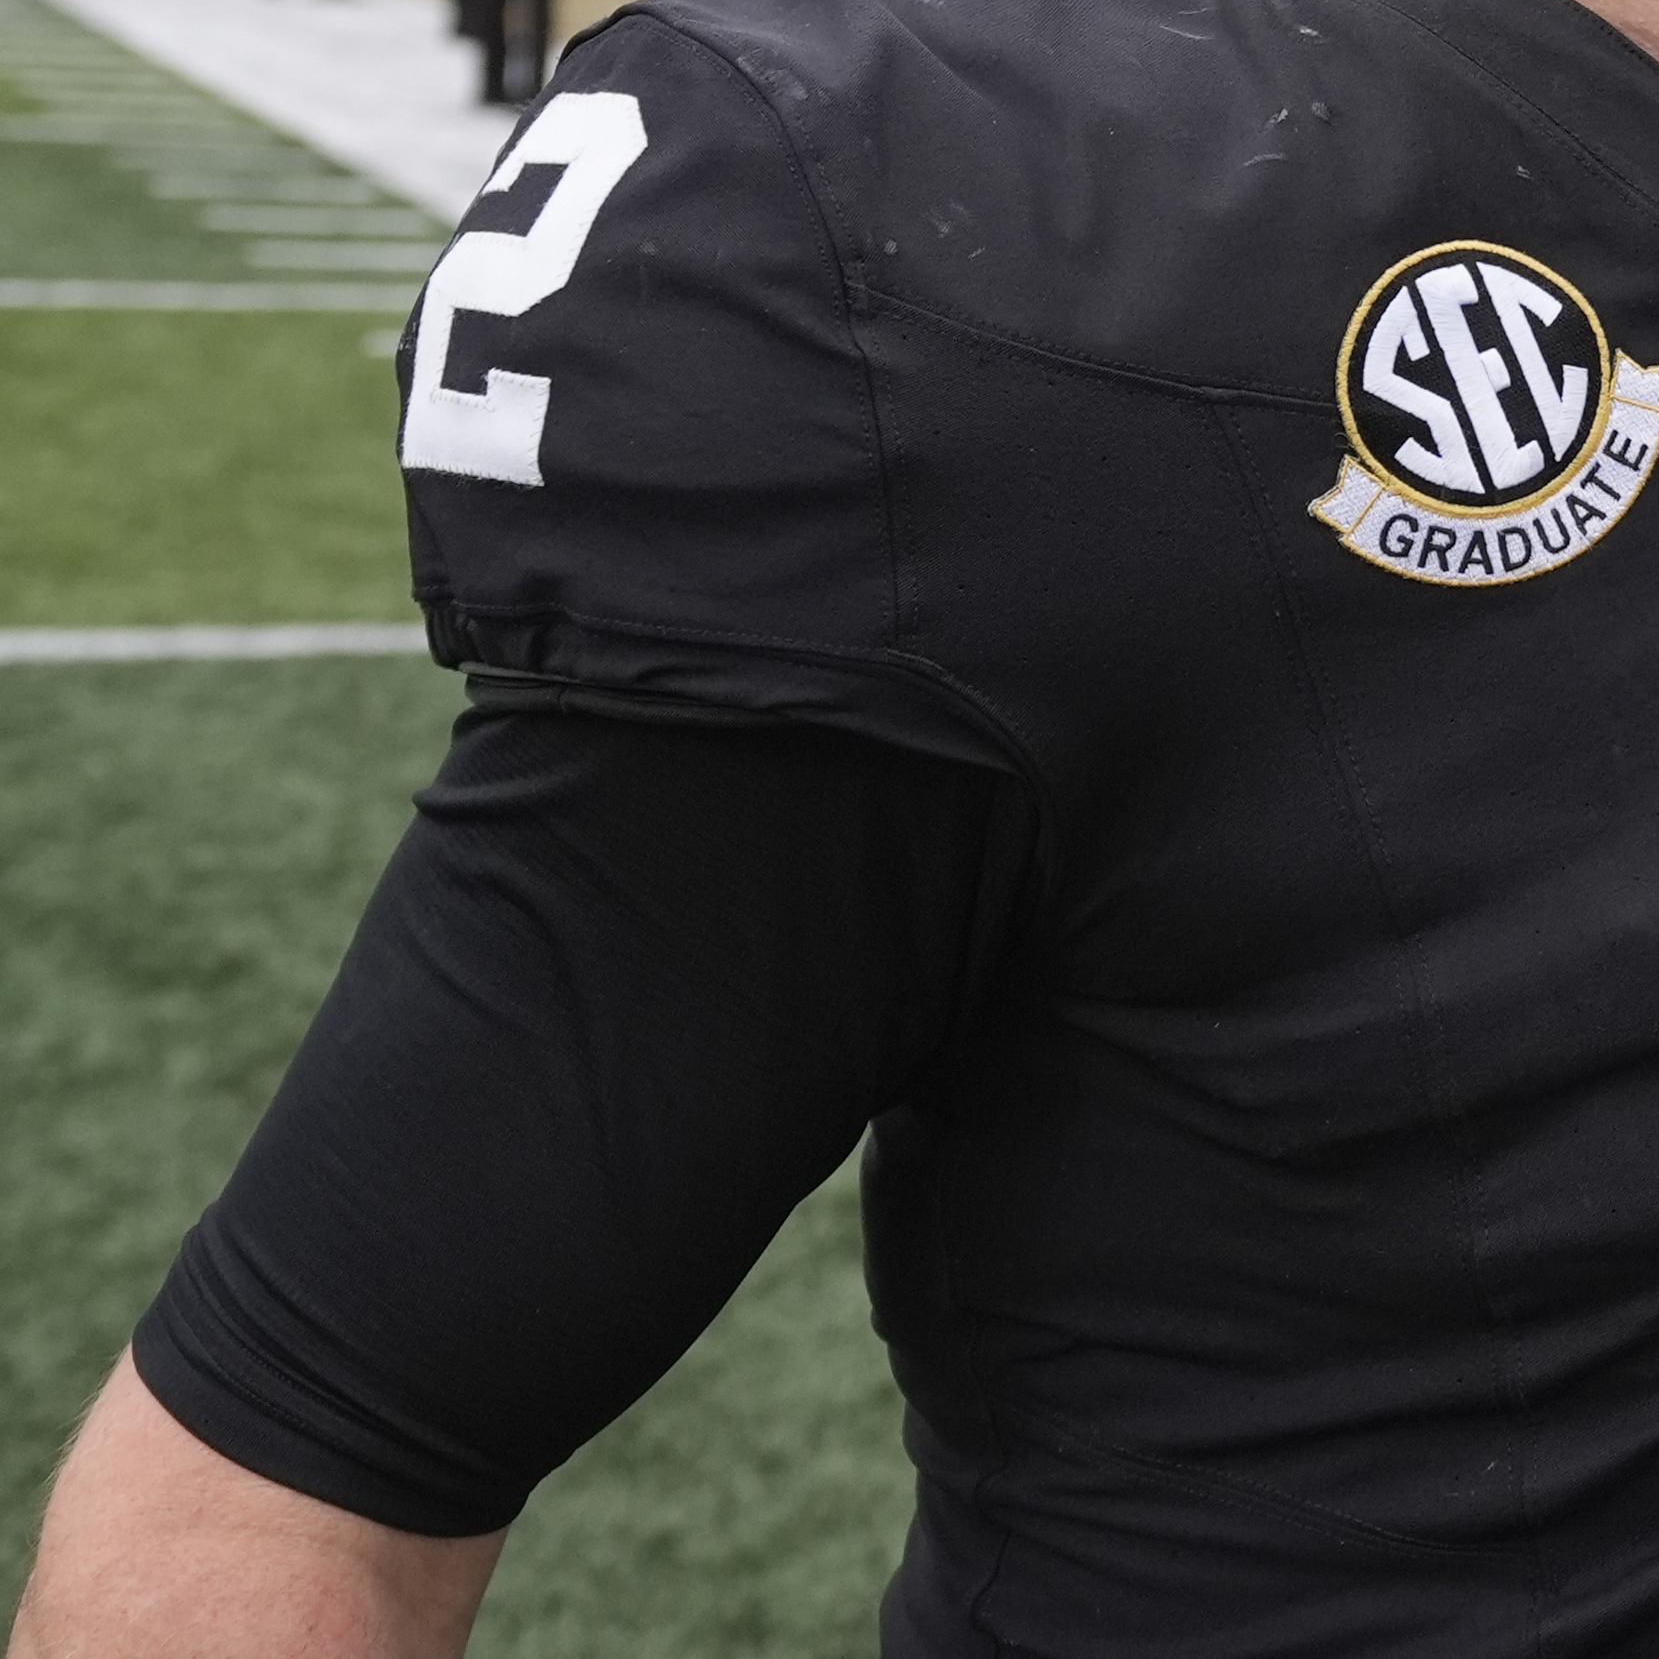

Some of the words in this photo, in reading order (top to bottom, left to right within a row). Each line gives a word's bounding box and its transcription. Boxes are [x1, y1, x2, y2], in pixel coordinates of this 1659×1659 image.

[402, 91, 649, 488] 2
[1362, 261, 1589, 495] SEC
[1377, 428, 1649, 576] GRADUATE
